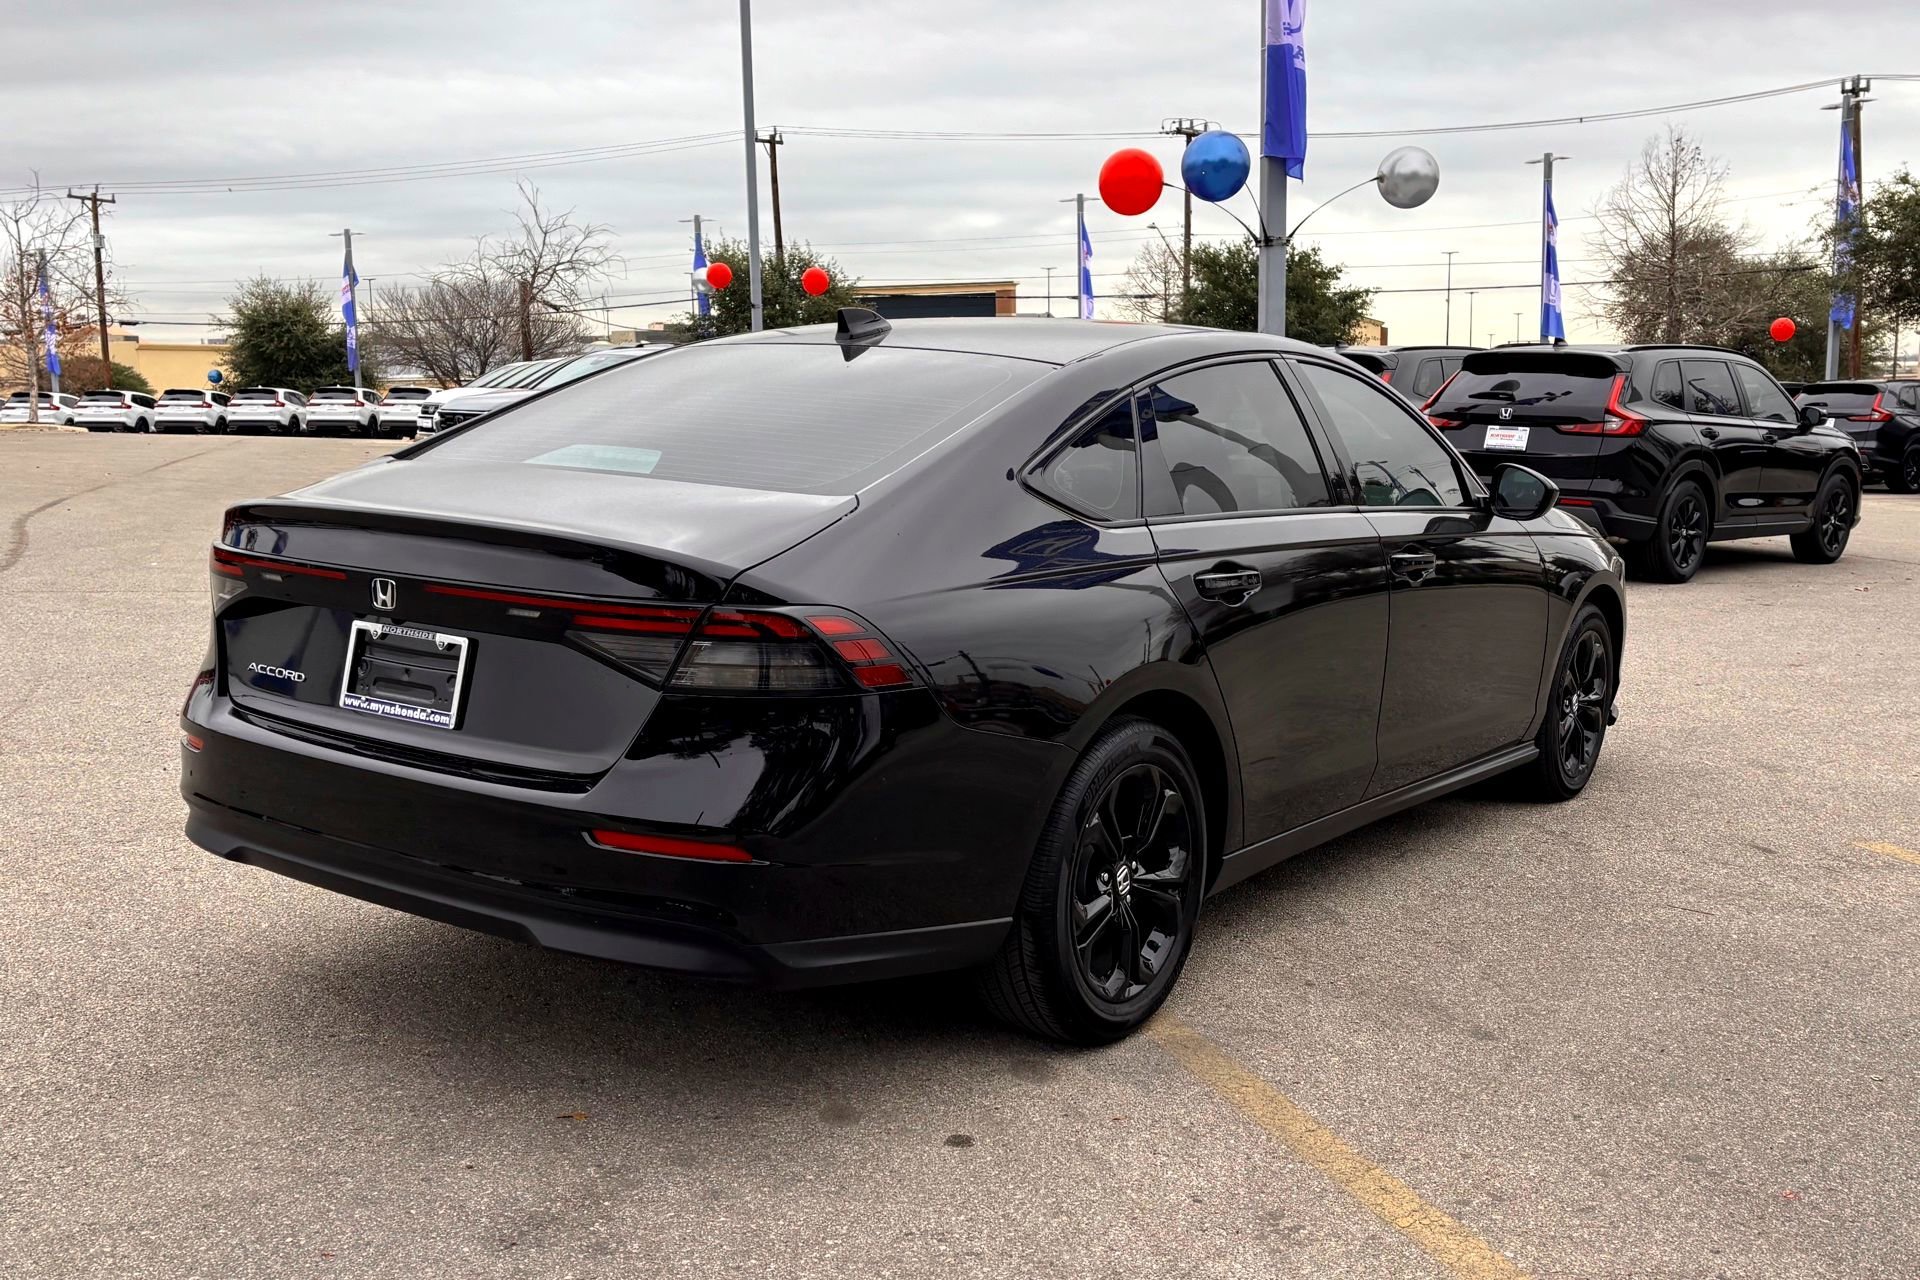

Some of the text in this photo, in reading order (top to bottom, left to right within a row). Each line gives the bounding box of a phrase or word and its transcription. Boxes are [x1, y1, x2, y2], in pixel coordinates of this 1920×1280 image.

[382, 625, 434, 640] NORTHSIDE
[247, 662, 306, 682] ACCORD
[344, 696, 450, 724] www.mynshonda.com
